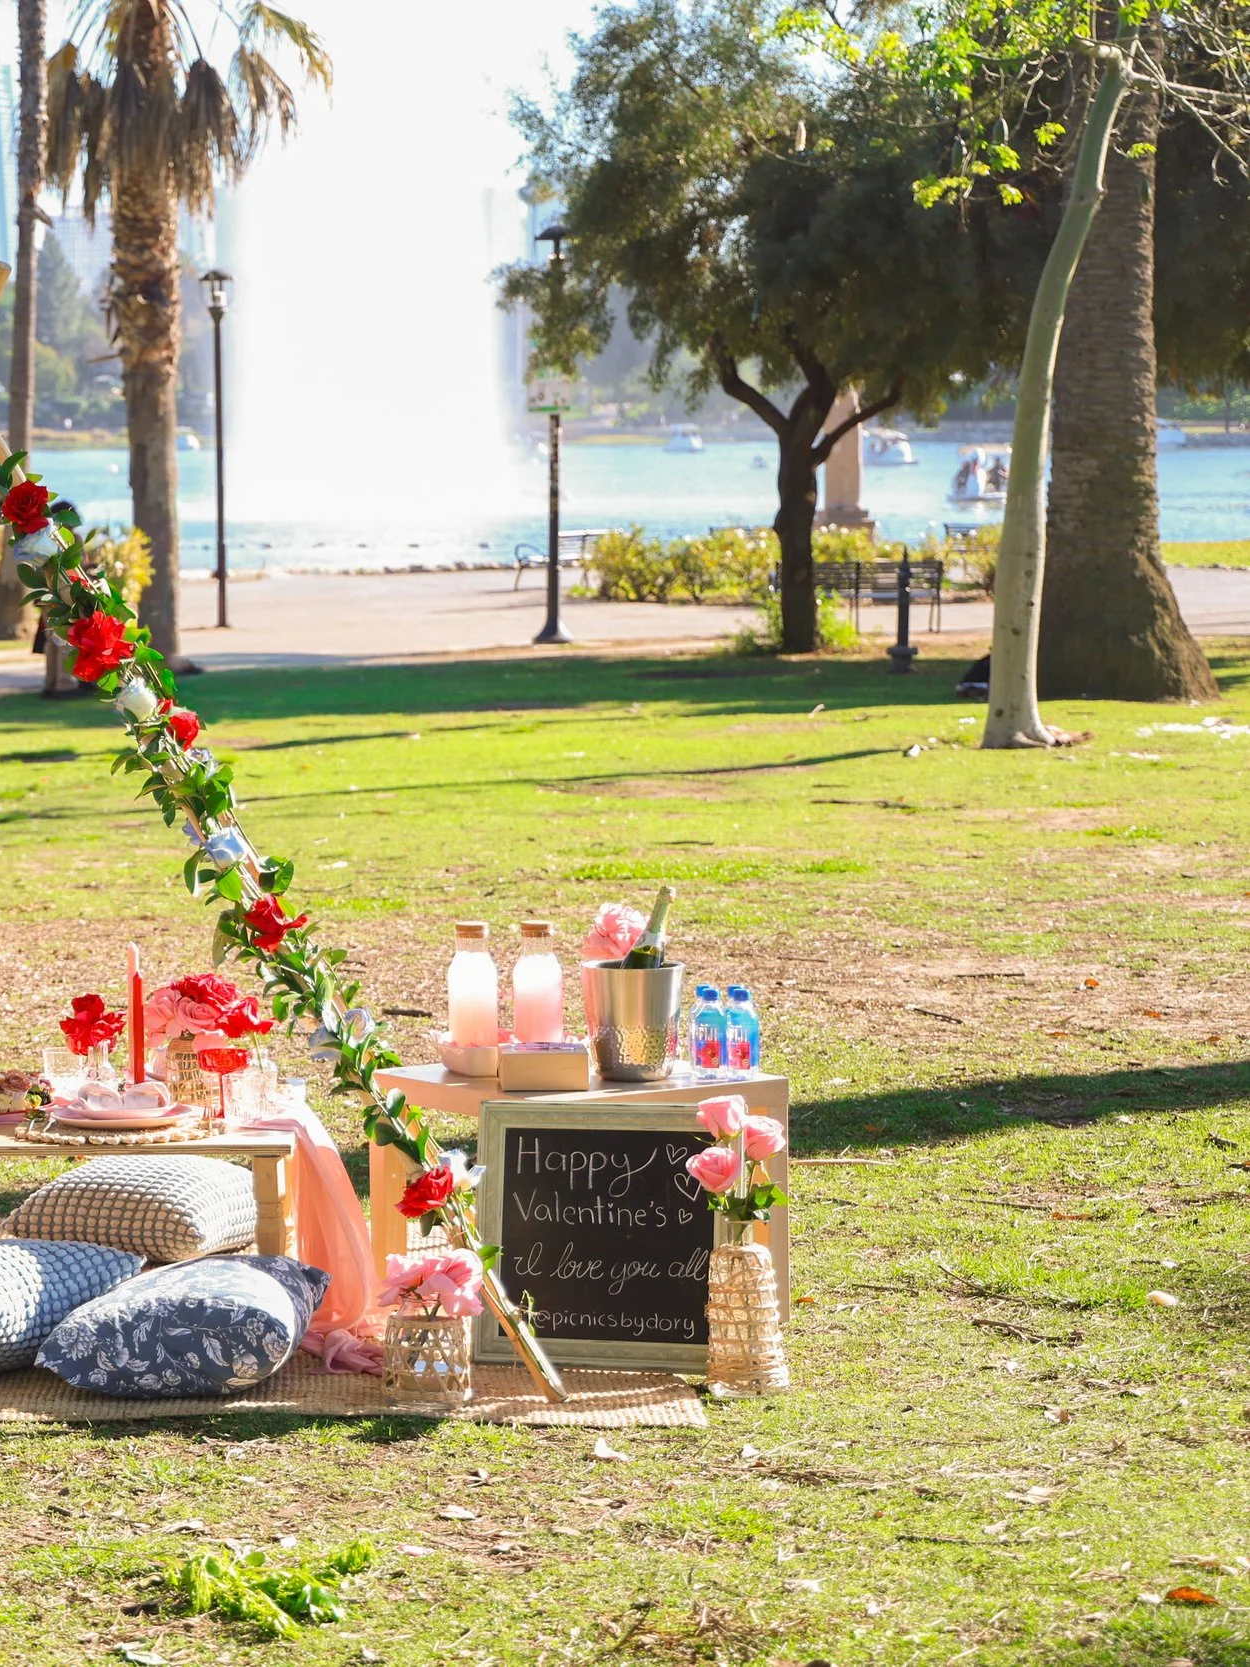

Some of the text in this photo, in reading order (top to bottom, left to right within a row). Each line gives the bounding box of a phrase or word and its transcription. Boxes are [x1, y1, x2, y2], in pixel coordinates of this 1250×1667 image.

[698, 1026, 718, 1041] FIJI
[517, 1136, 657, 1198] Happy
[512, 1189, 667, 1227] Valentine's
[513, 1241, 709, 1295] I love you all
[533, 1309, 695, 1340] @picnicsbydory
